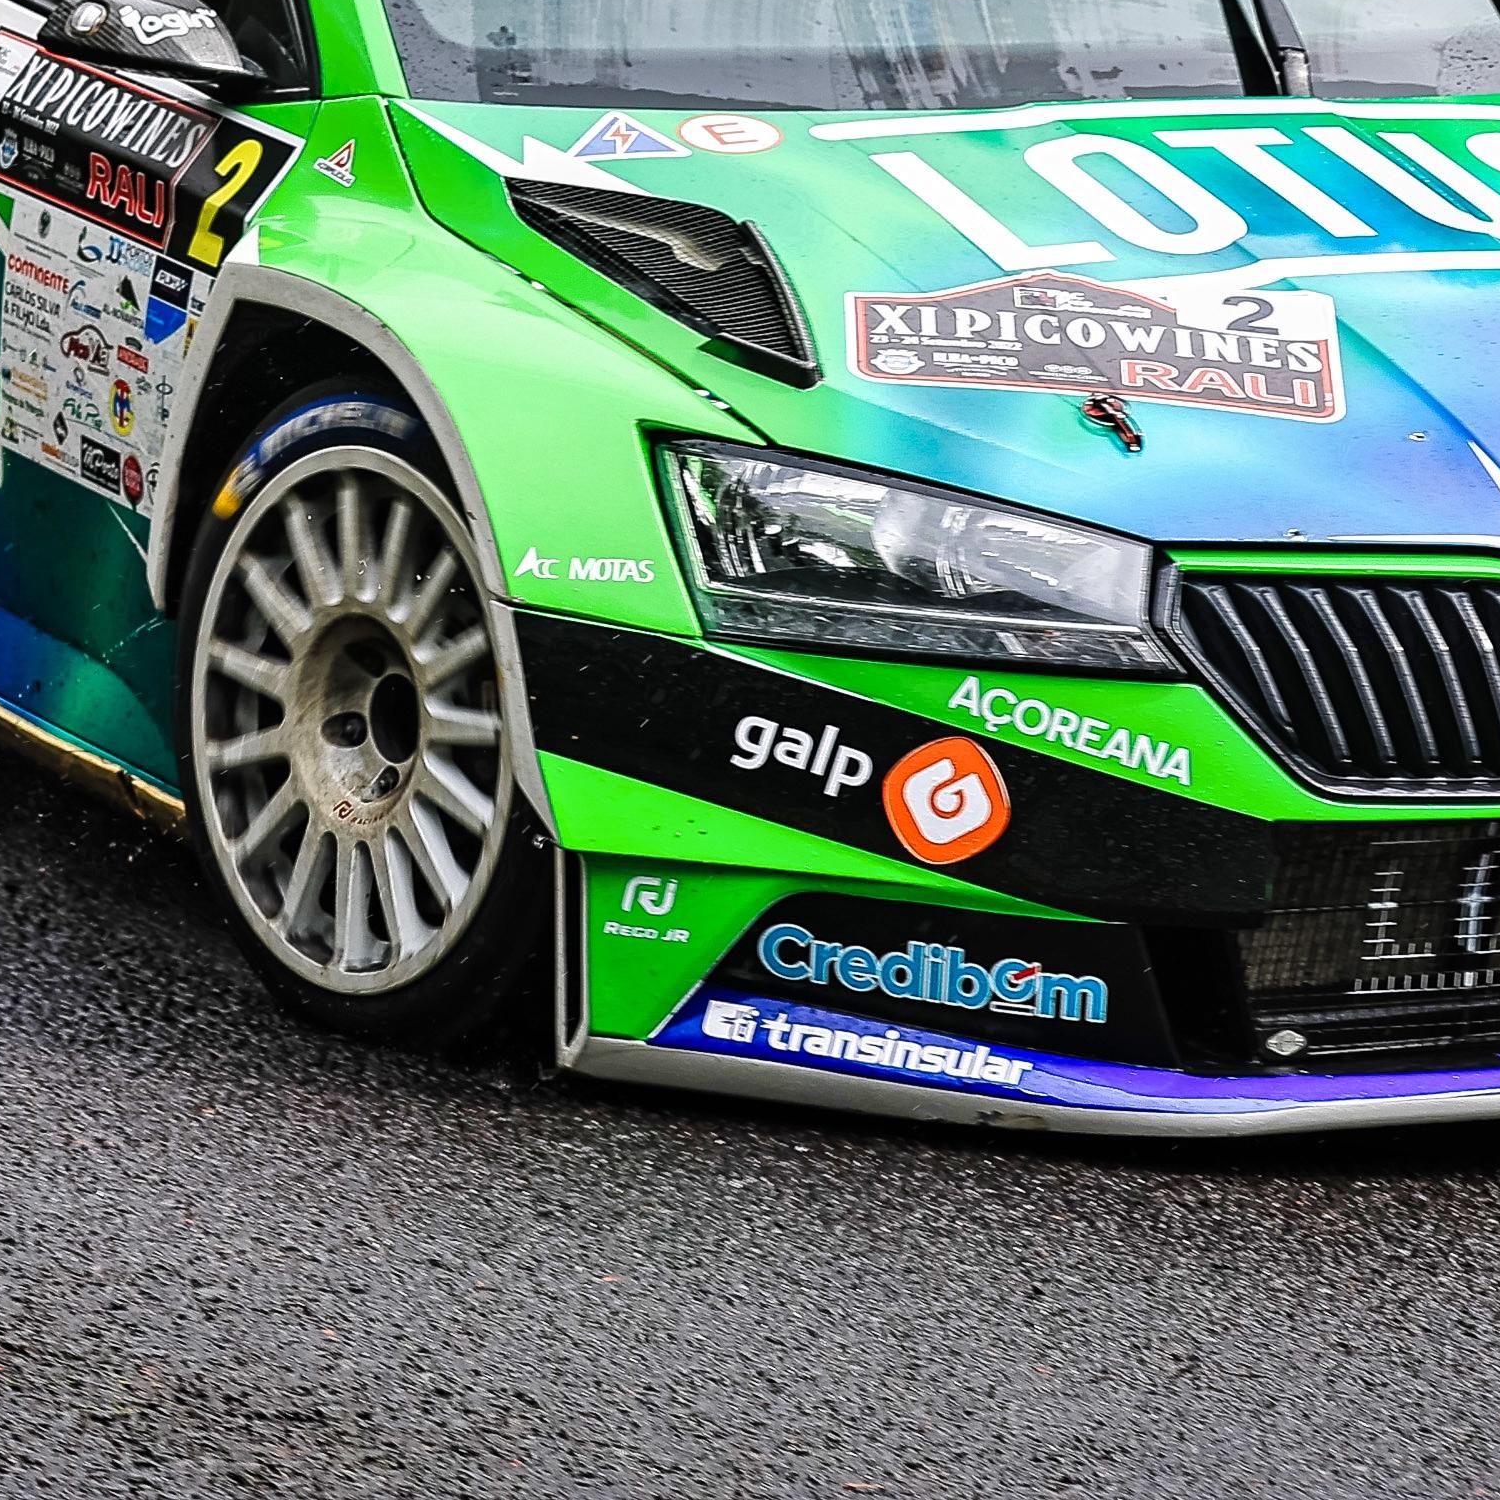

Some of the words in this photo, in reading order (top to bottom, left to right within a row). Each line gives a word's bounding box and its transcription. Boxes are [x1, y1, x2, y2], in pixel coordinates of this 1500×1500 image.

[34, 67, 208, 169] PICOWINES
[701, 120, 764, 147] E
[86, 152, 165, 228] RALI
[187, 138, 264, 268] 2
[952, 307, 1322, 373] PICOWINES
[1223, 295, 1279, 334] 2
[1120, 358, 1327, 407] RALI
[568, 557, 655, 583] MOTAS
[729, 715, 873, 796] galp
[948, 675, 1191, 786] AÇOREANA
[760, 1012, 1033, 1086] transinsular
